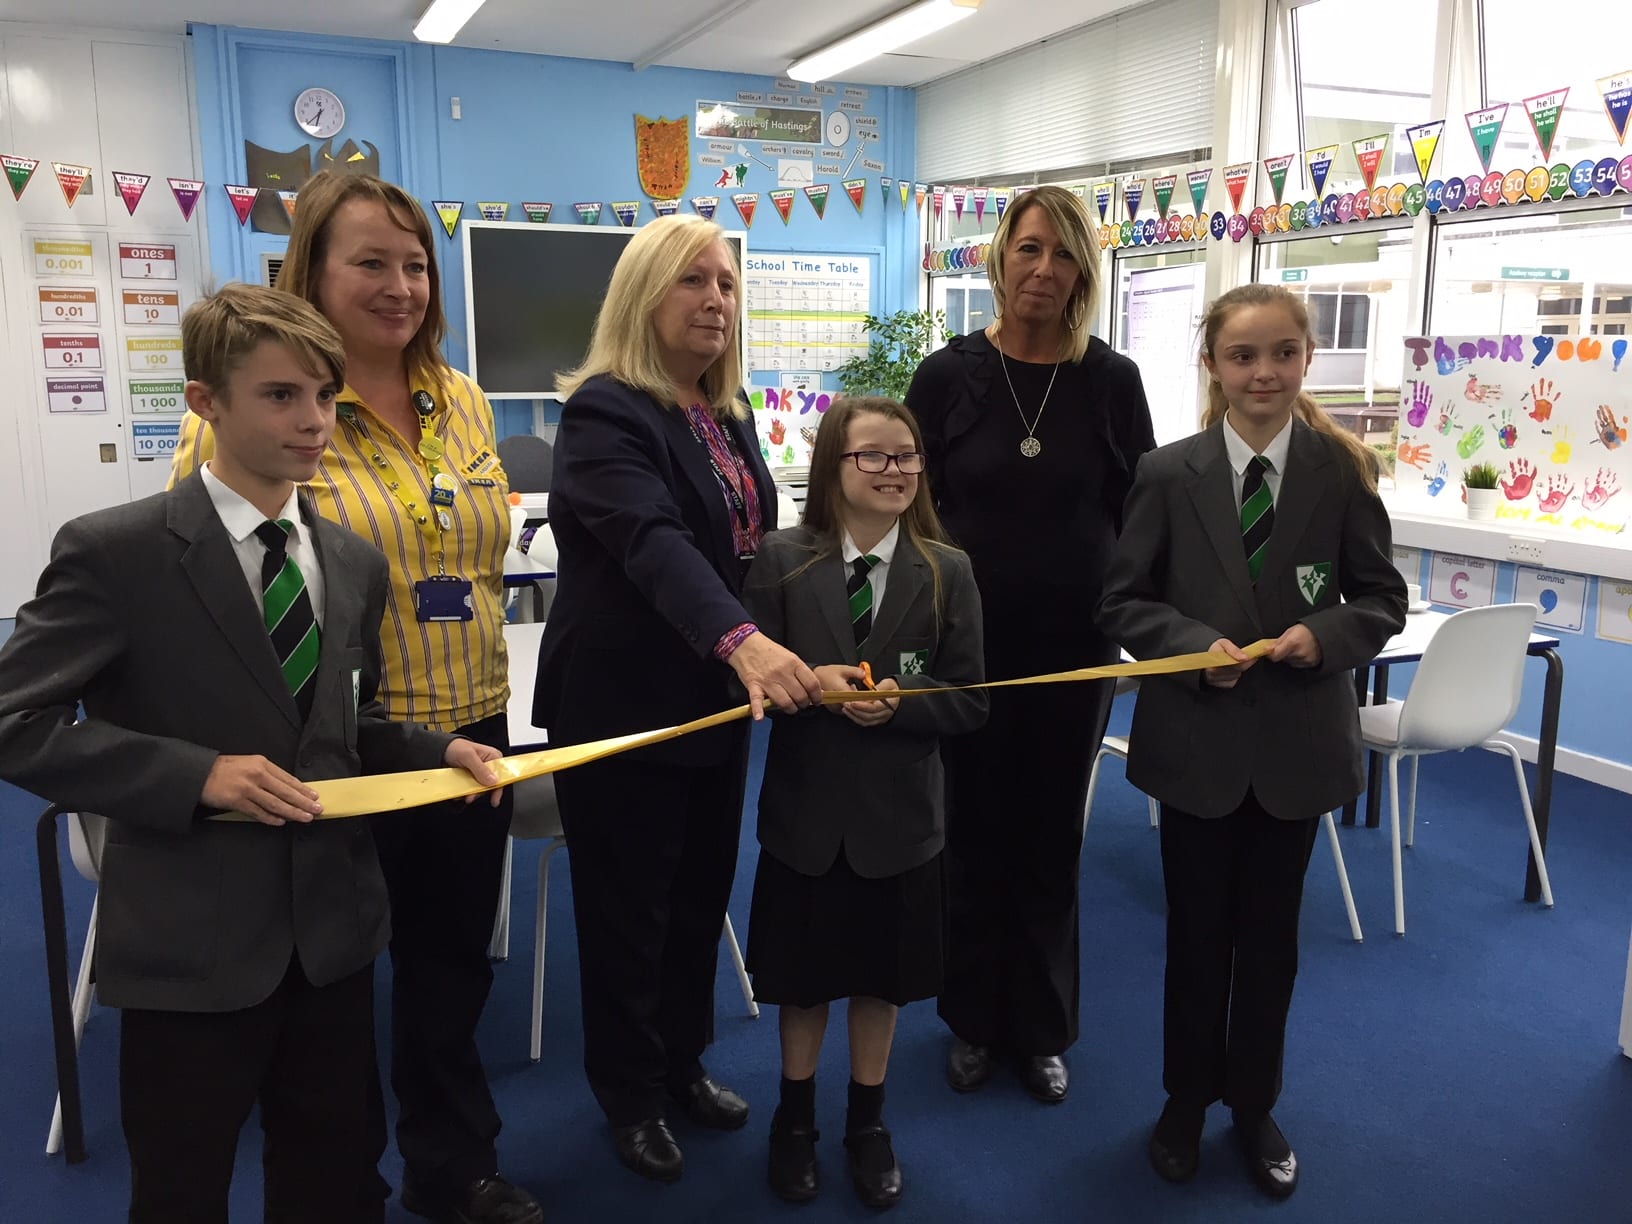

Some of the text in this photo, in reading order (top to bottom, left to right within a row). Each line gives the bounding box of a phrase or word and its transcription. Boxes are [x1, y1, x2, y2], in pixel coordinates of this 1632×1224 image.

[1537, 96, 1556, 108] he'll
[1611, 99, 1628, 109] he is
[1478, 114, 1494, 123] I've
[1545, 116, 1555, 124] will
[733, 119, 808, 132] Battle of Hastings
[858, 131, 871, 139] eye
[1419, 129, 1431, 138] I'm
[710, 143, 733, 151] armour
[1365, 141, 1375, 150] I'll
[792, 148, 814, 157] cavalry
[1317, 152, 1326, 160] I'd
[5, 160, 33, 169] they're
[816, 165, 839, 173] Harold
[1550, 172, 1567, 187] 52
[1574, 168, 1593, 183] 53
[1596, 167, 1616, 183] 54
[179, 181, 194, 189] isn't
[1483, 179, 1500, 195] 49
[1505, 177, 1524, 192] 50
[1530, 175, 1545, 189] 51
[1406, 190, 1422, 204] 45
[1427, 189, 1442, 201] 46
[1445, 185, 1462, 199] 47
[1293, 208, 1306, 221] 38
[1169, 221, 1179, 232] 28
[1181, 221, 1192, 231] 29
[1213, 217, 1224, 231] 33
[1122, 227, 1131, 237] 24
[1133, 226, 1143, 236] 25
[1144, 226, 1154, 236] 26
[131, 248, 164, 259] ones
[45, 258, 83, 269] 0.001
[145, 262, 152, 274] 1
[747, 259, 859, 274] School Time Table
[137, 294, 164, 305] tens
[55, 306, 83, 317] 0.01
[144, 308, 159, 319] 10
[60, 339, 83, 347] tenths
[132, 340, 177, 349] hundreds
[62, 351, 83, 364] 0.1
[145, 354, 168, 365] 100
[80, 383, 98, 391] point
[133, 385, 181, 393] thousands
[466, 451, 491, 473] IKEA
[710, 458, 723, 476] STAFF
[435, 489, 446, 498] 20
[1537, 573, 1565, 585] comma
[1450, 571, 1470, 600] C
